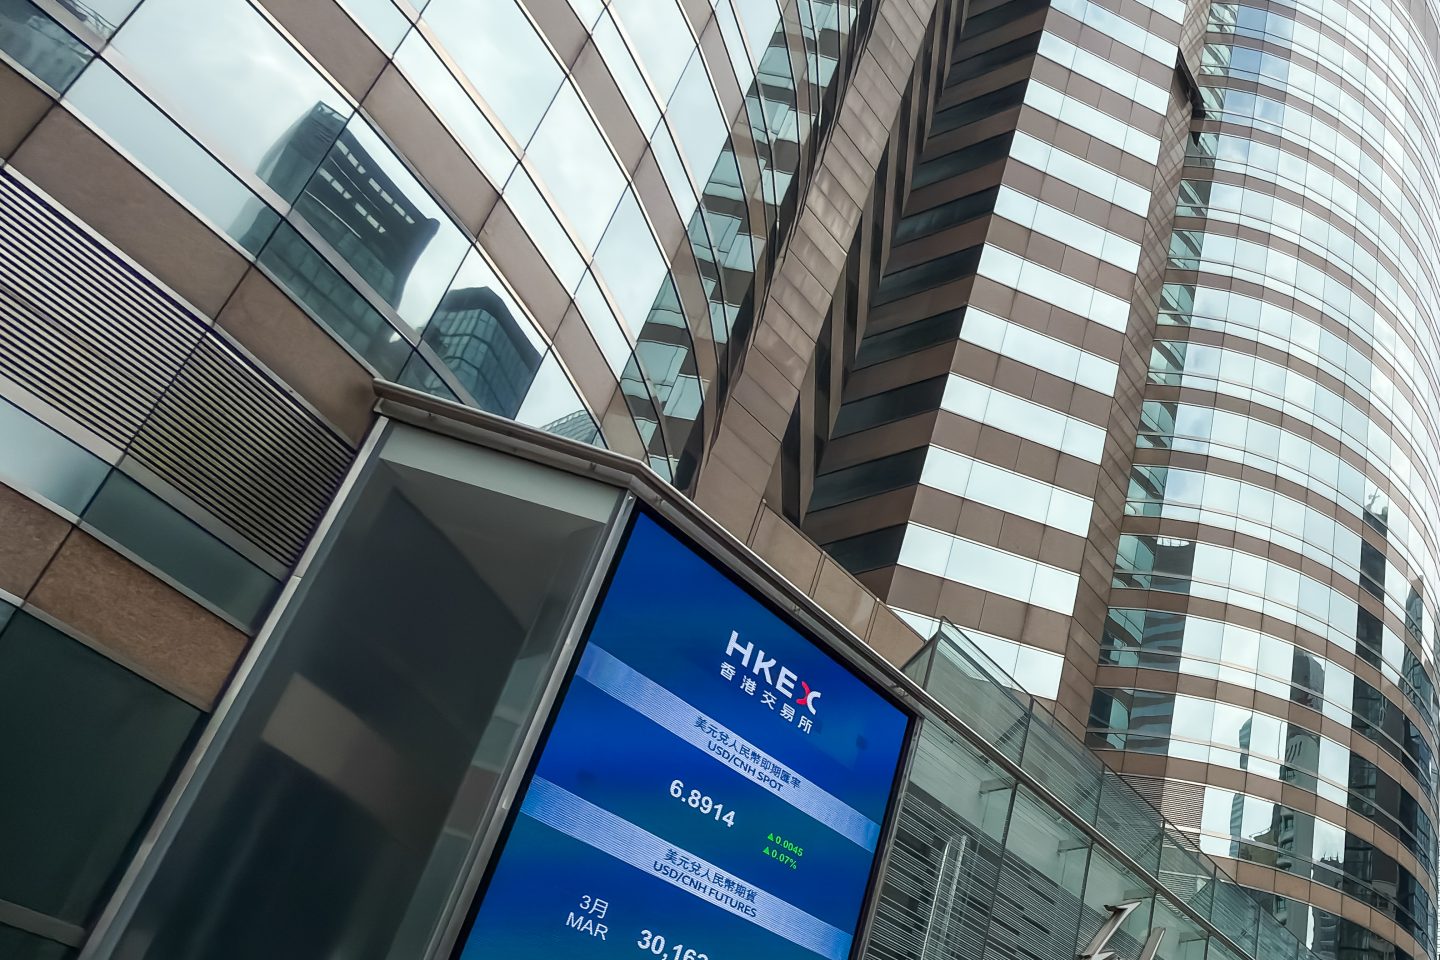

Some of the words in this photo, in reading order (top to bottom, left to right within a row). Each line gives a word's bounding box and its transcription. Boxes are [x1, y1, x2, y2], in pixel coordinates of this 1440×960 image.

[720, 661, 813, 734] 香港交易所
[725, 630, 821, 715] HKEX
[707, 741, 756, 777] USD/CNH
[756, 771, 784, 792] SPOT
[669, 779, 736, 828] 6.8914
[653, 861, 708, 894] USD/CNH
[708, 888, 757, 918] FUTURES
[664, 848, 758, 905] 美元兌人民幣期貨
[565, 912, 609, 941] MAR
[579, 894, 609, 919] 3月
